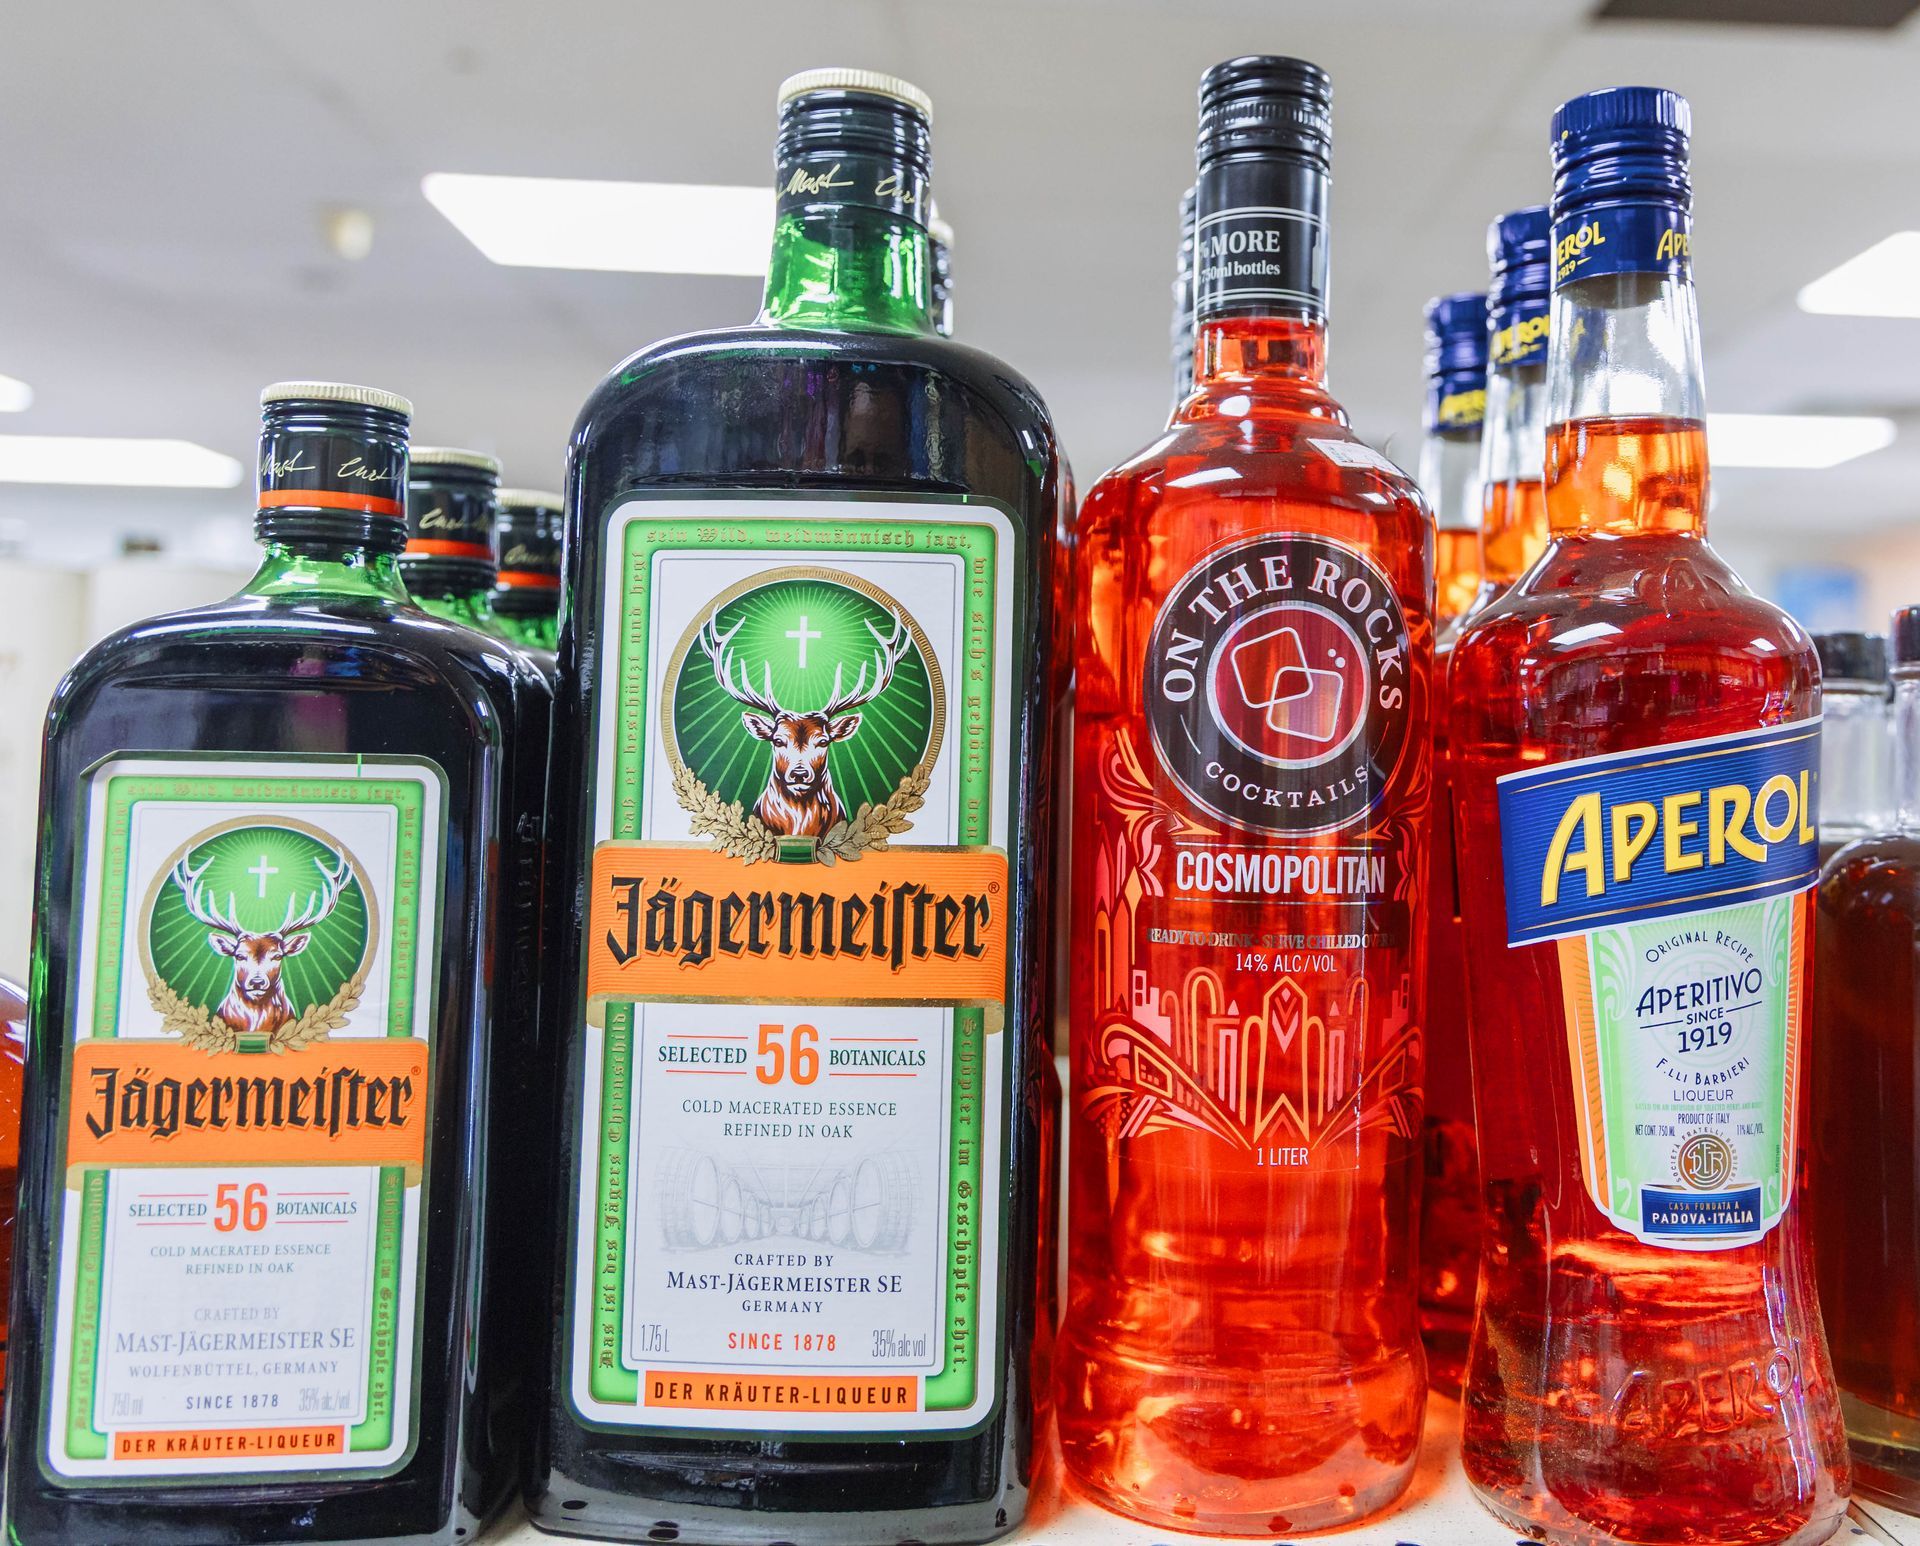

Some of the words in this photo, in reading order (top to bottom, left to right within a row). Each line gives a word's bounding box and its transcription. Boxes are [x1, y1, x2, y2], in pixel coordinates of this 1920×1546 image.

[1211, 230, 1281, 259] MORE
[1556, 221, 1606, 266] EROL
[1234, 260, 1281, 276] bottles
[646, 528, 688, 544] sein
[924, 532, 973, 550] jagt,
[630, 551, 646, 595] hegt
[972, 556, 989, 598] wie
[630, 605, 644, 645] und
[1162, 628, 1205, 703] ON
[1188, 554, 1294, 625] THE
[1307, 556, 1404, 711] ROCKS
[624, 765, 637, 787] er
[1204, 760, 1370, 808] COCKTAILS
[965, 798, 979, 841] den
[1540, 768, 1816, 907] APEROL
[1175, 850, 1387, 896] COSMOPOLITAN
[1208, 932, 1255, 948] DRINK
[1261, 934, 1305, 950] SERVE
[1306, 933, 1361, 950] CHILLED
[1646, 930, 1709, 962] ORIGINAL
[1715, 930, 1754, 963] RECIPE
[1236, 952, 1269, 972] 14%
[1635, 967, 1763, 1018] APERITIVO
[1686, 1007, 1725, 1025] SINCE
[1677, 1021, 1733, 1054] 1919
[657, 1044, 748, 1065] SELECTED
[754, 1023, 820, 1086] 56
[828, 1048, 927, 1068] BOTANICALS
[1694, 1056, 1751, 1087] BARBIERI
[1673, 1089, 1735, 1102] LIQUEUR
[681, 1099, 723, 1115] COLD
[728, 1100, 824, 1117] MACERATED
[828, 1101, 898, 1117] ESSENCE
[1677, 1112, 1706, 1125] PRODUCT
[1706, 1112, 1715, 1124] OF
[1715, 1112, 1731, 1124] ITALY
[722, 1122, 793, 1138] REFINED
[798, 1123, 817, 1138] IN
[820, 1124, 854, 1139] OAK
[1634, 1124, 1644, 1136] NET
[1658, 1125, 1668, 1137] 750
[957, 1136, 971, 1167] im
[1256, 1148, 1265, 1166] 1
[1269, 1147, 1310, 1167] LITER
[128, 1202, 208, 1218] SELECTED
[213, 1182, 269, 1233] 56
[276, 1200, 358, 1216] BOTANICALS
[1668, 1202, 1690, 1211] CASA
[150, 1245, 186, 1258] COLD
[189, 1244, 271, 1257] MACERATED
[274, 1243, 332, 1256] ESSENCE
[602, 1239, 619, 1273] des
[733, 1252, 809, 1267] CRAFTED
[813, 1253, 835, 1268] BY
[184, 1262, 244, 1275] REFINED
[248, 1262, 264, 1274] IN
[267, 1261, 296, 1274] OAK
[876, 1274, 904, 1294] SE
[600, 1279, 617, 1313] ist
[741, 1298, 824, 1315] GERMANY
[193, 1307, 260, 1322] CRAFTED
[262, 1306, 281, 1321] BY
[329, 1327, 356, 1350] SE
[599, 1323, 616, 1369] Das
[641, 1324, 662, 1353] 1.75
[728, 1331, 784, 1352] SINCE
[793, 1332, 837, 1353] 1878
[872, 1328, 896, 1358] 35%
[897, 1333, 911, 1357] alc
[912, 1333, 927, 1357] vol
[128, 1362, 259, 1379] WOLFENBÜTTEL,
[263, 1360, 339, 1376] GERMANY
[186, 1395, 234, 1410] SINCE
[242, 1393, 280, 1409] 1878
[653, 1380, 695, 1401] DER
[704, 1381, 909, 1406] KRÄUTER-LIQUEUR
[122, 1438, 156, 1454] DER
[166, 1431, 337, 1453] KRÄUTER-LIQUEUR
